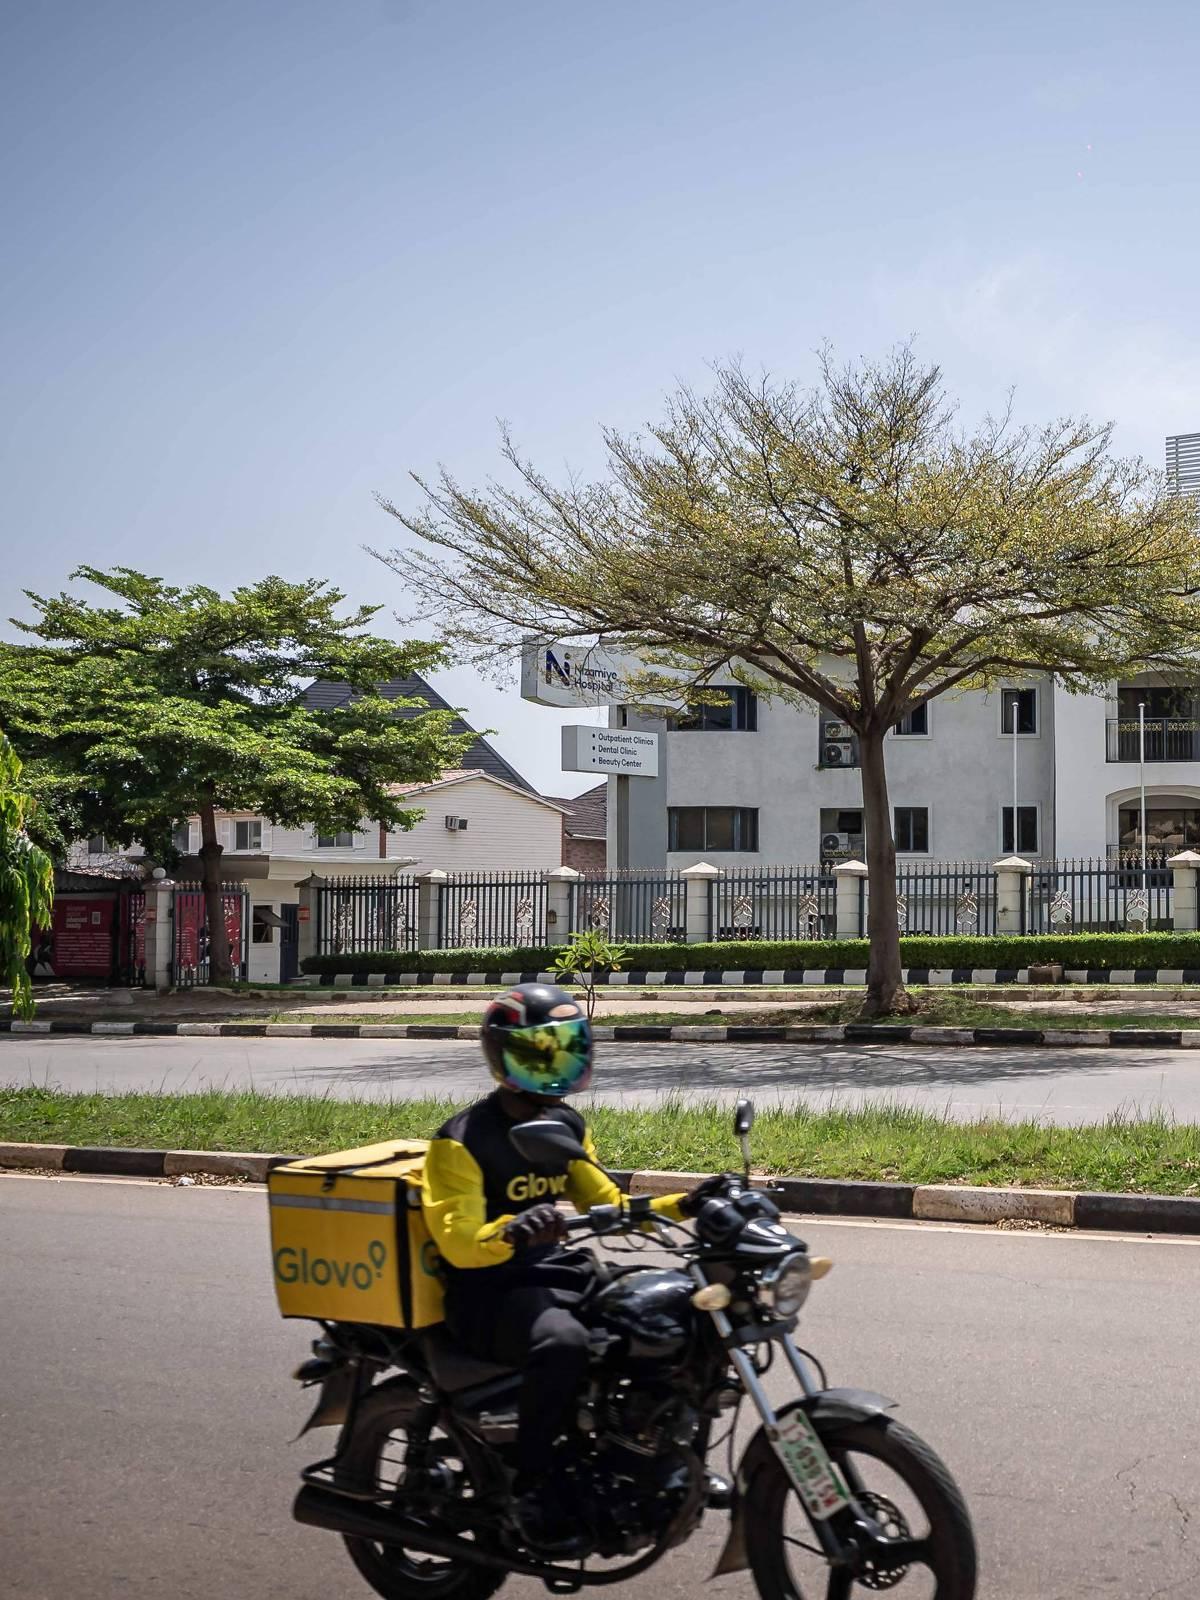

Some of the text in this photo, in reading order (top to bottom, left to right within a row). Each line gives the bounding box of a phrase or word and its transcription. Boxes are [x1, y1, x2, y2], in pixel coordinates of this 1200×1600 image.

[598, 732, 654, 746] Outpatient Clinics
[598, 745, 638, 756] Dental Clinic
[598, 757, 642, 769] Beauty Center
[273, 1246, 373, 1291] Glovo
